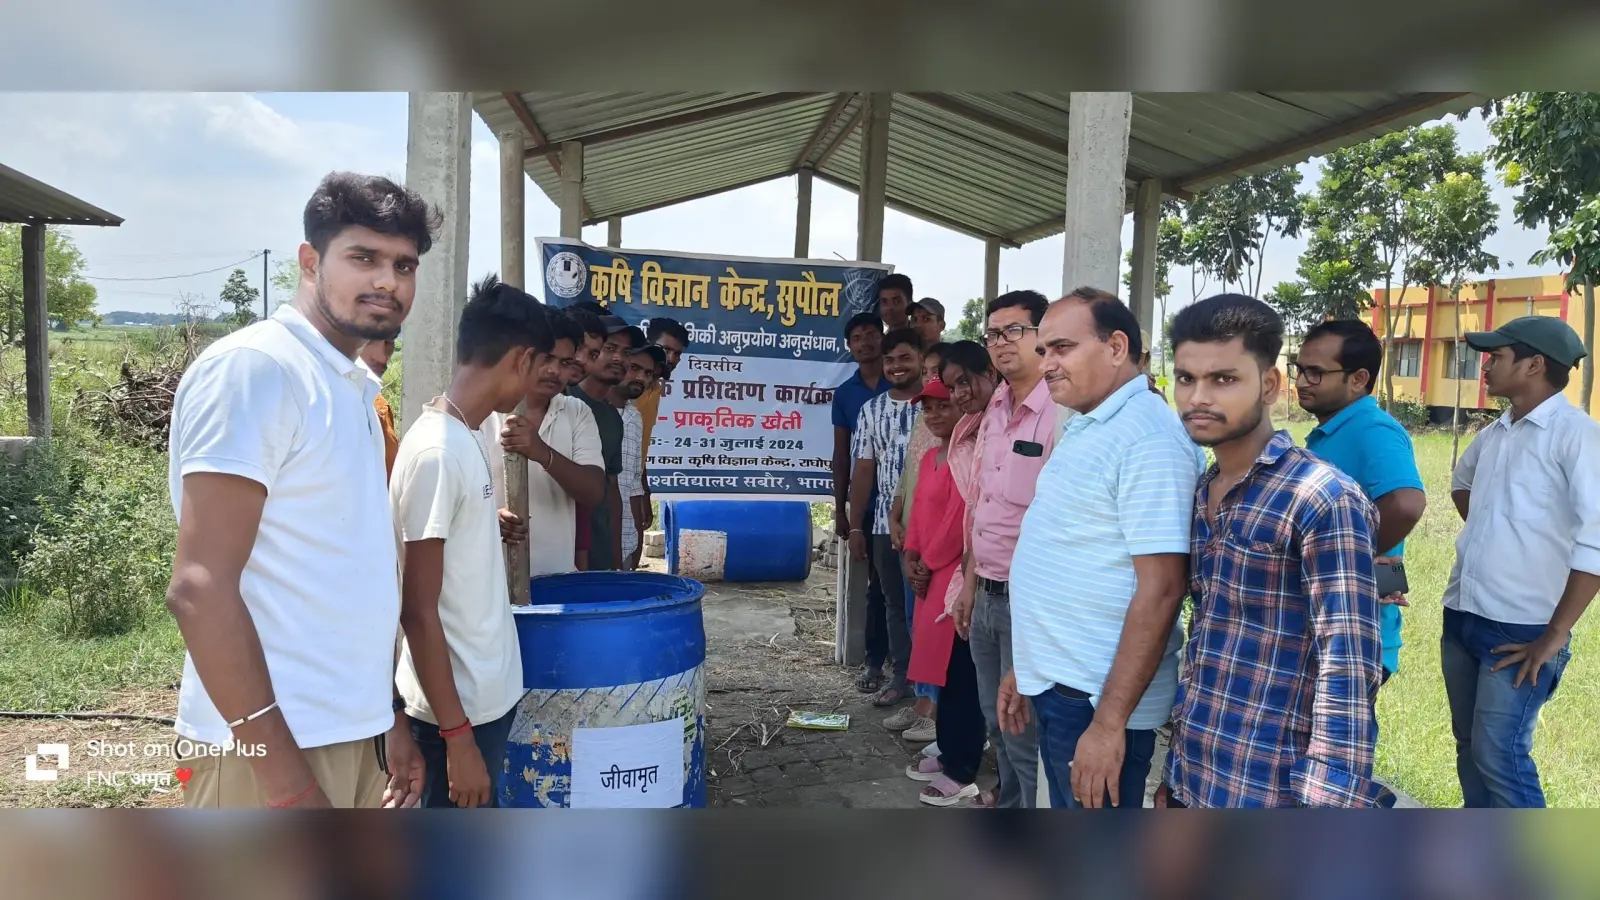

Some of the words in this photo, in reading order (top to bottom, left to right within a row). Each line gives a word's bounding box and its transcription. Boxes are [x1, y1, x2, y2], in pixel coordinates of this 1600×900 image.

[589, 258, 634, 308] कृषि
[640, 260, 711, 309] विज्ञान
[718, 326, 776, 354] अनुप्रयोग
[688, 355, 743, 373] दिवसीय
[682, 375, 767, 402] प्रशिक्षण
[774, 381, 836, 405] कार्यक्र
[673, 406, 757, 434] प्राकृतिक
[761, 409, 803, 431] खेती
[719, 435, 765, 451] जुलाई
[769, 439, 804, 451] 2024
[658, 455, 683, 465] कक्ष
[688, 453, 715, 468] कृषि
[718, 454, 758, 466] विज्ञान
[798, 456, 833, 472] राघोपु
[646, 471, 739, 488] श्वविद्यालय
[599, 764, 660, 794] जीवामृत
